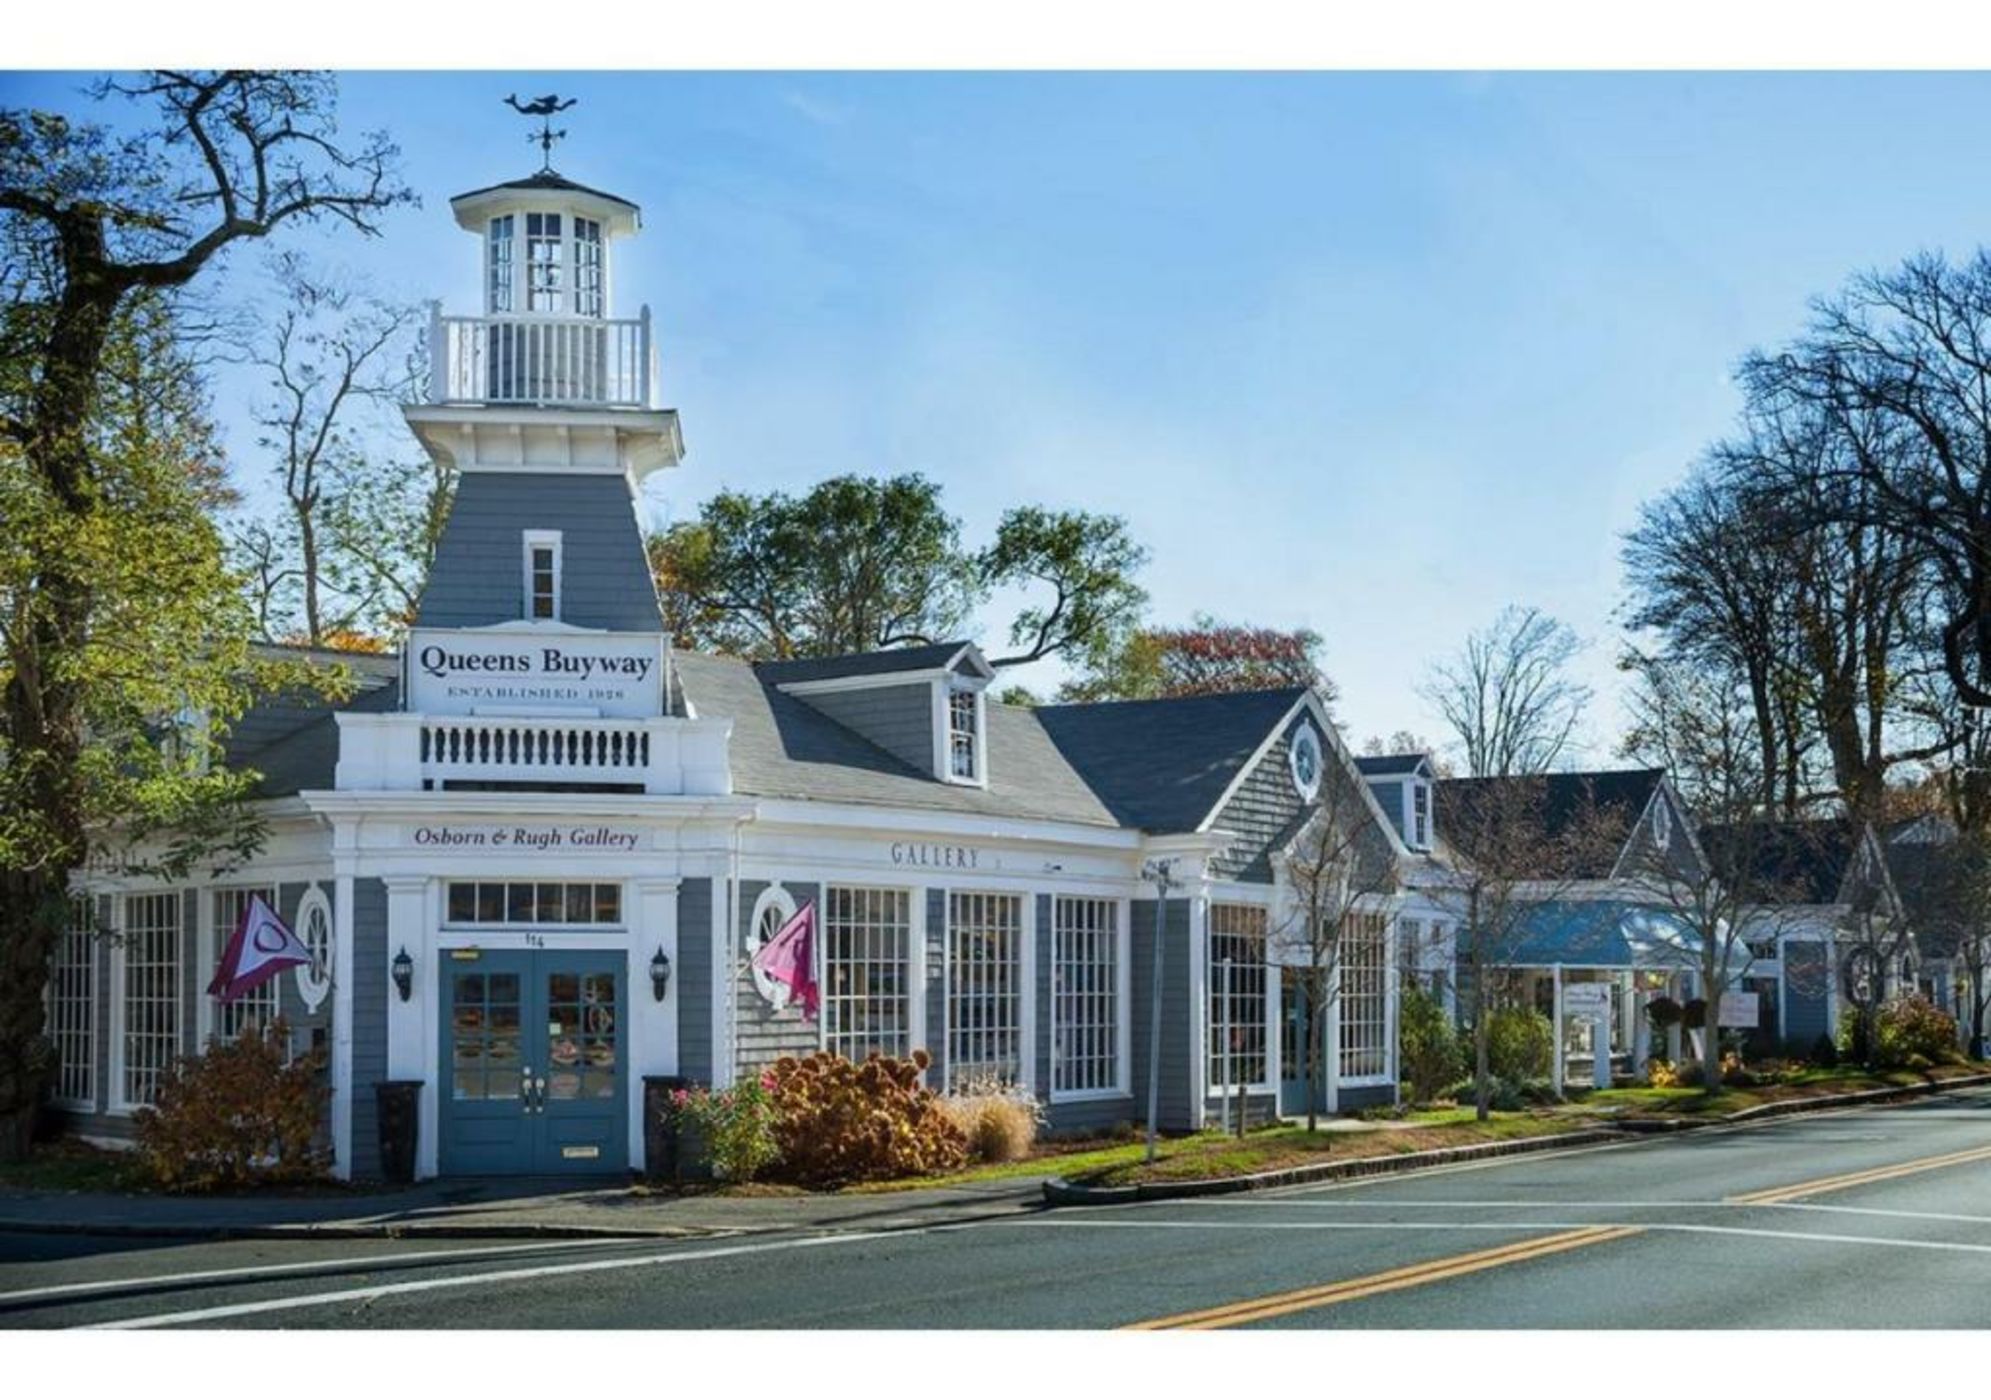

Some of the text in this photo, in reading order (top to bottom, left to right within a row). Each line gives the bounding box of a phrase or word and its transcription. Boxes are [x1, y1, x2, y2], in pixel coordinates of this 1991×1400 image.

[420, 645, 654, 682] Queens Buyway
[447, 686, 579, 699] ESTABLISHED
[415, 827, 639, 851] Osborn & Rugh Gallery
[891, 842, 980, 869] GALLERY
